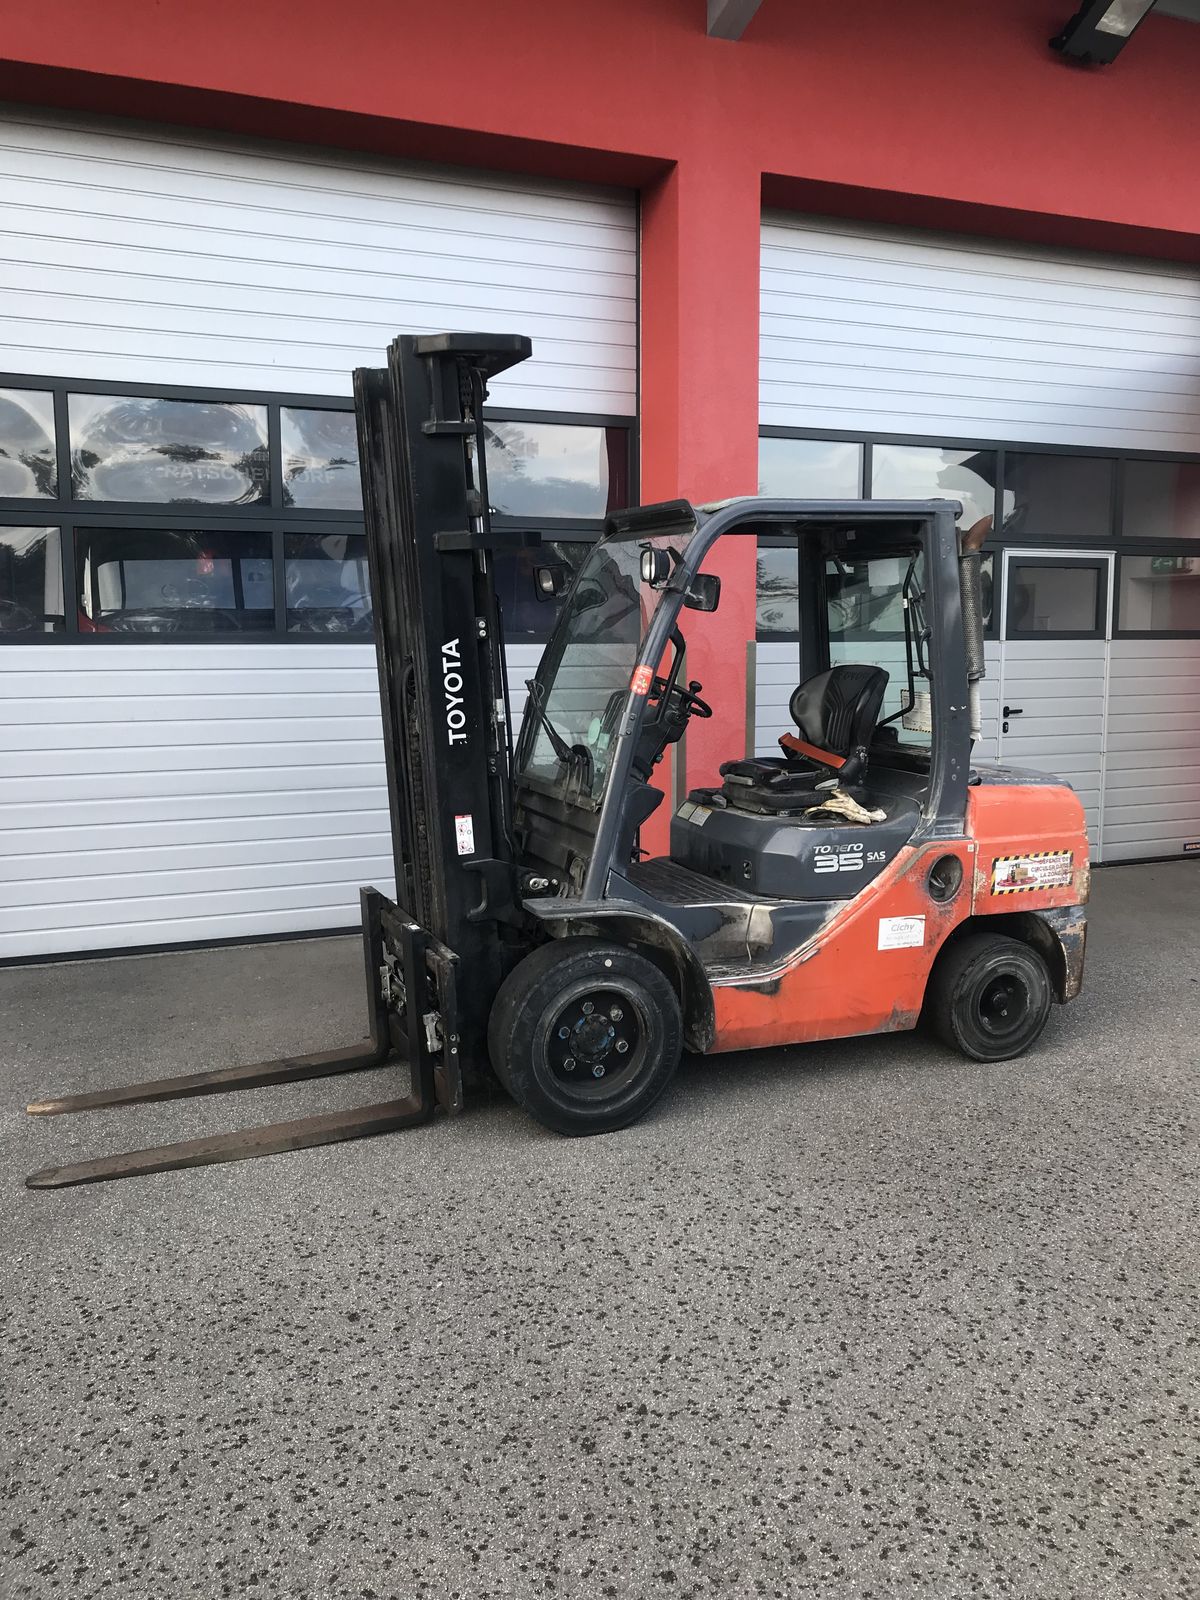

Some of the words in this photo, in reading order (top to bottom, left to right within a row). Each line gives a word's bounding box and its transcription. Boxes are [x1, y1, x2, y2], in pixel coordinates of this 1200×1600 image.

[441, 638, 467, 746] TOYOTA
[813, 852, 864, 873] 35
[866, 851, 886, 861] SAS
[891, 923, 915, 933] Cichy
